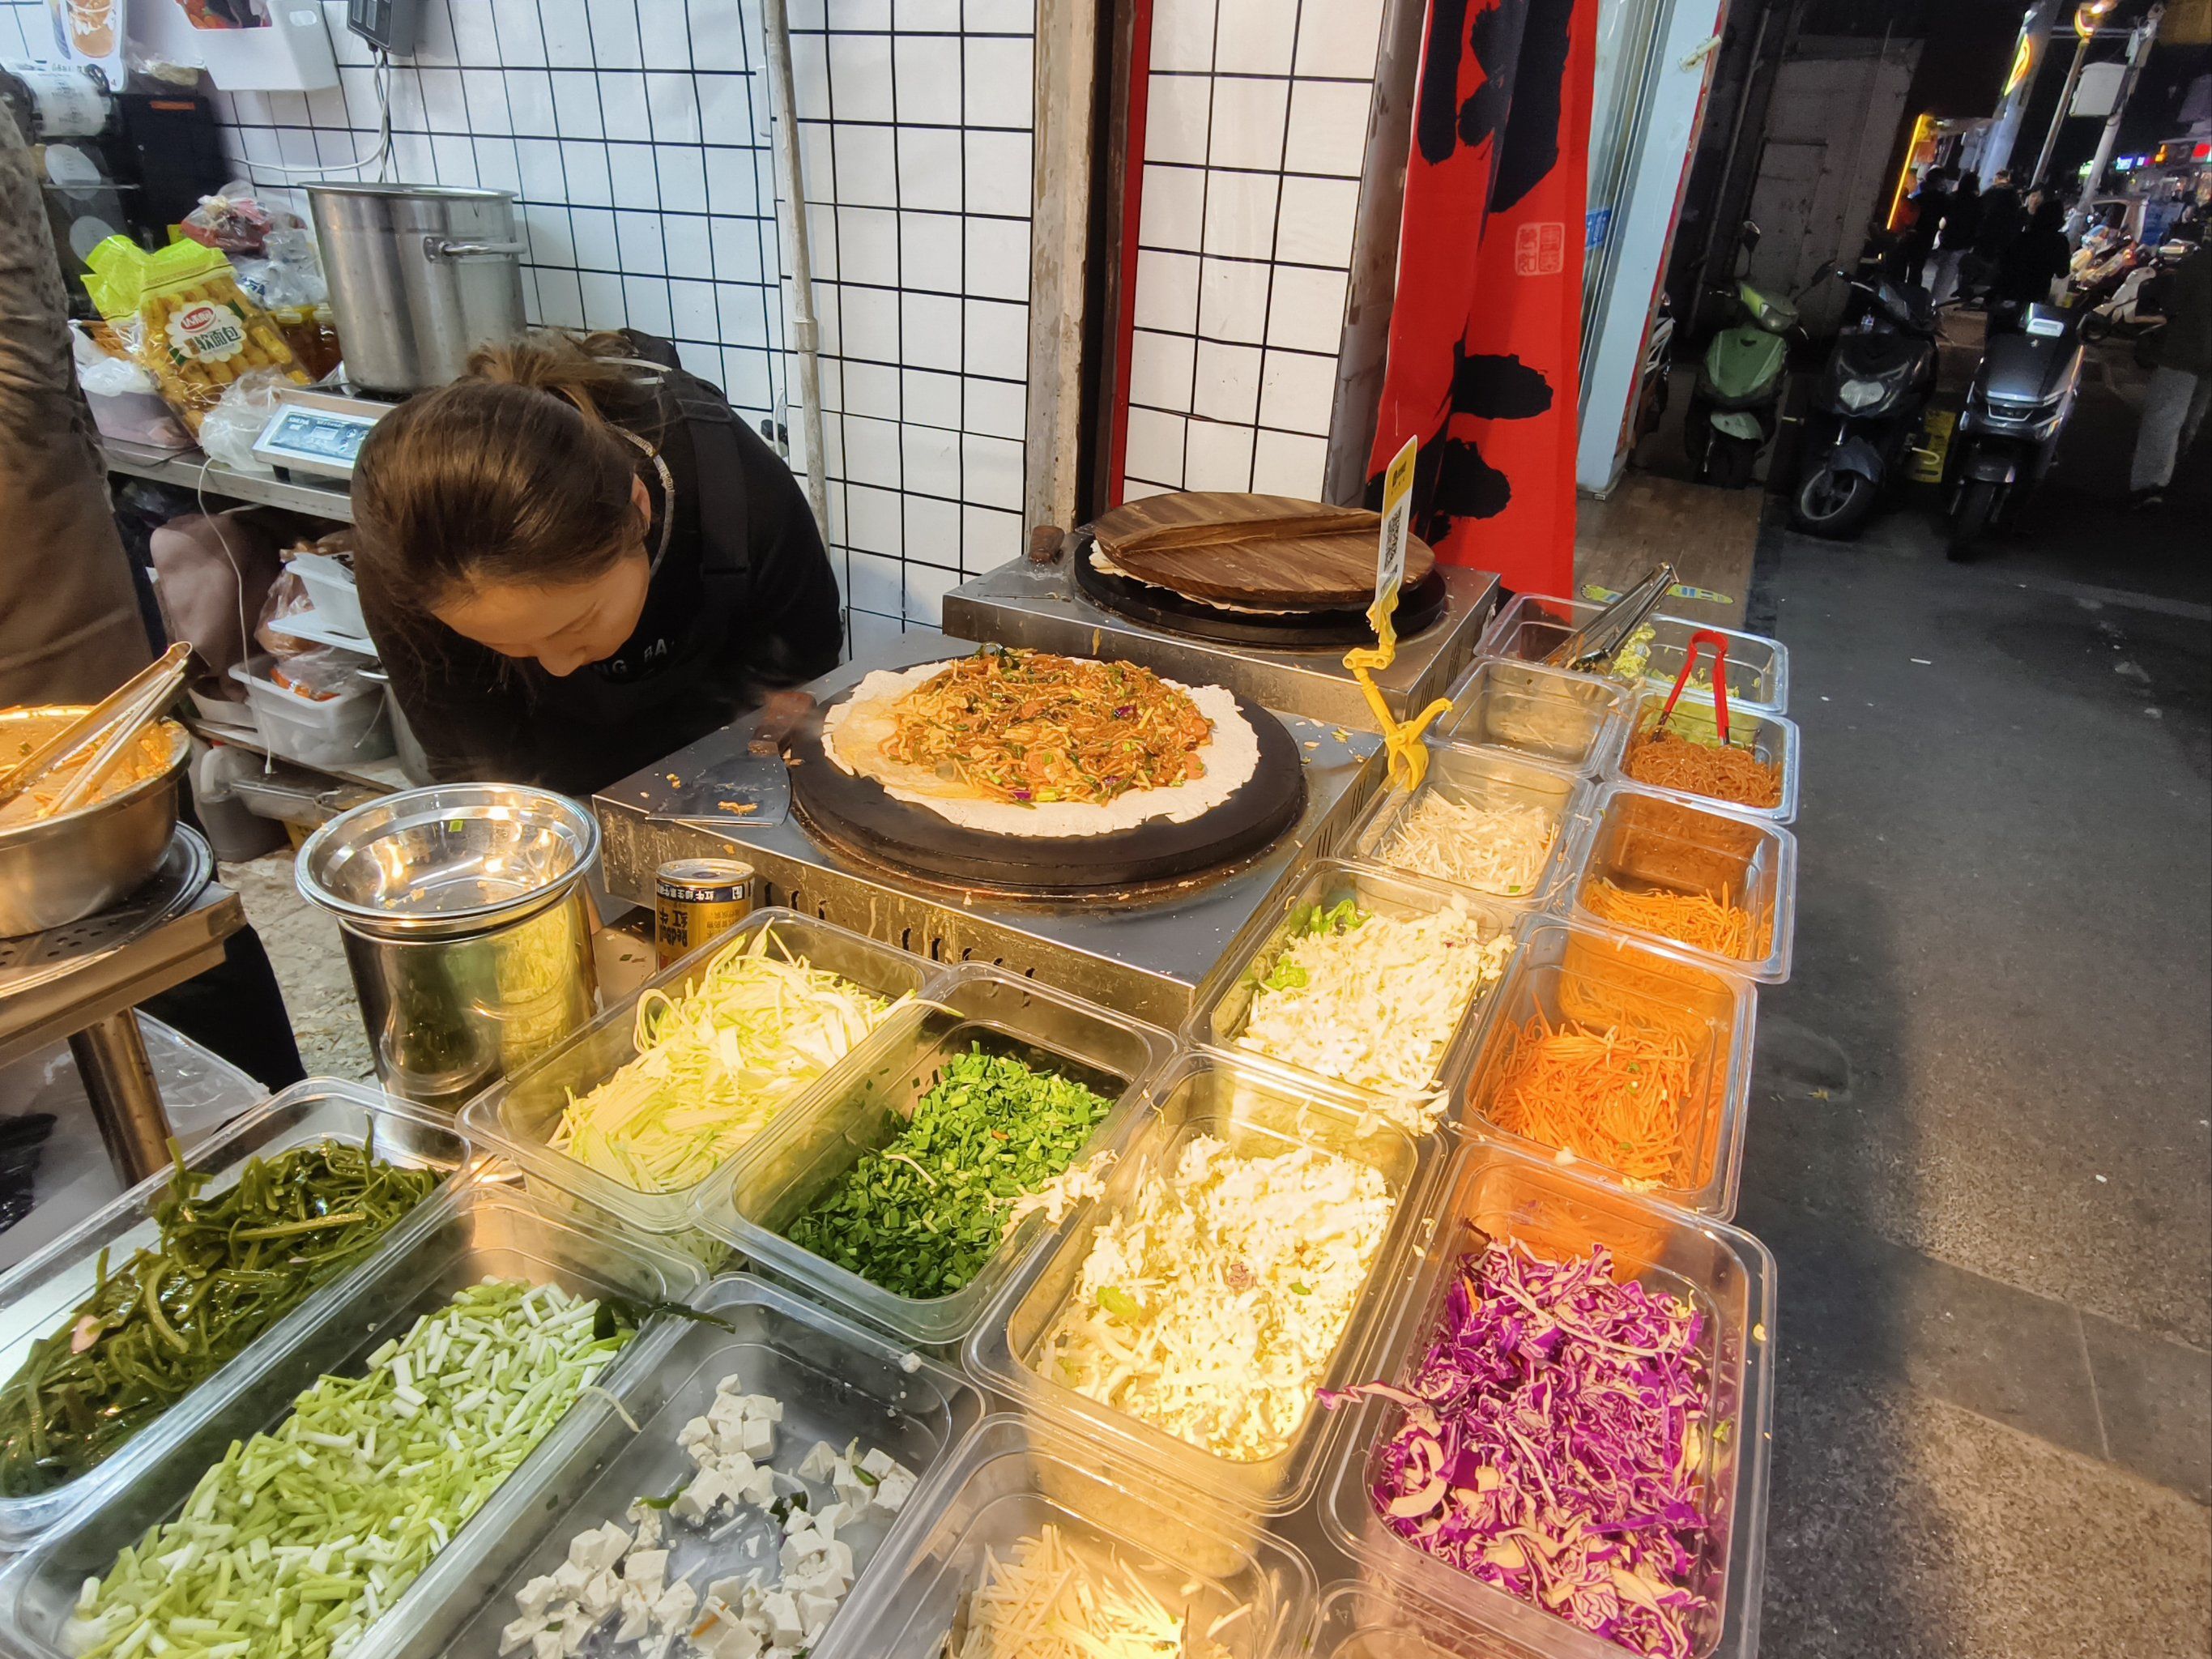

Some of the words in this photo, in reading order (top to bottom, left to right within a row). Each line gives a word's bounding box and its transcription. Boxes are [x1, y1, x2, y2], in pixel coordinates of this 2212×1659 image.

[194, 326, 241, 351] 软面包
[659, 908, 688, 928] 红牛
